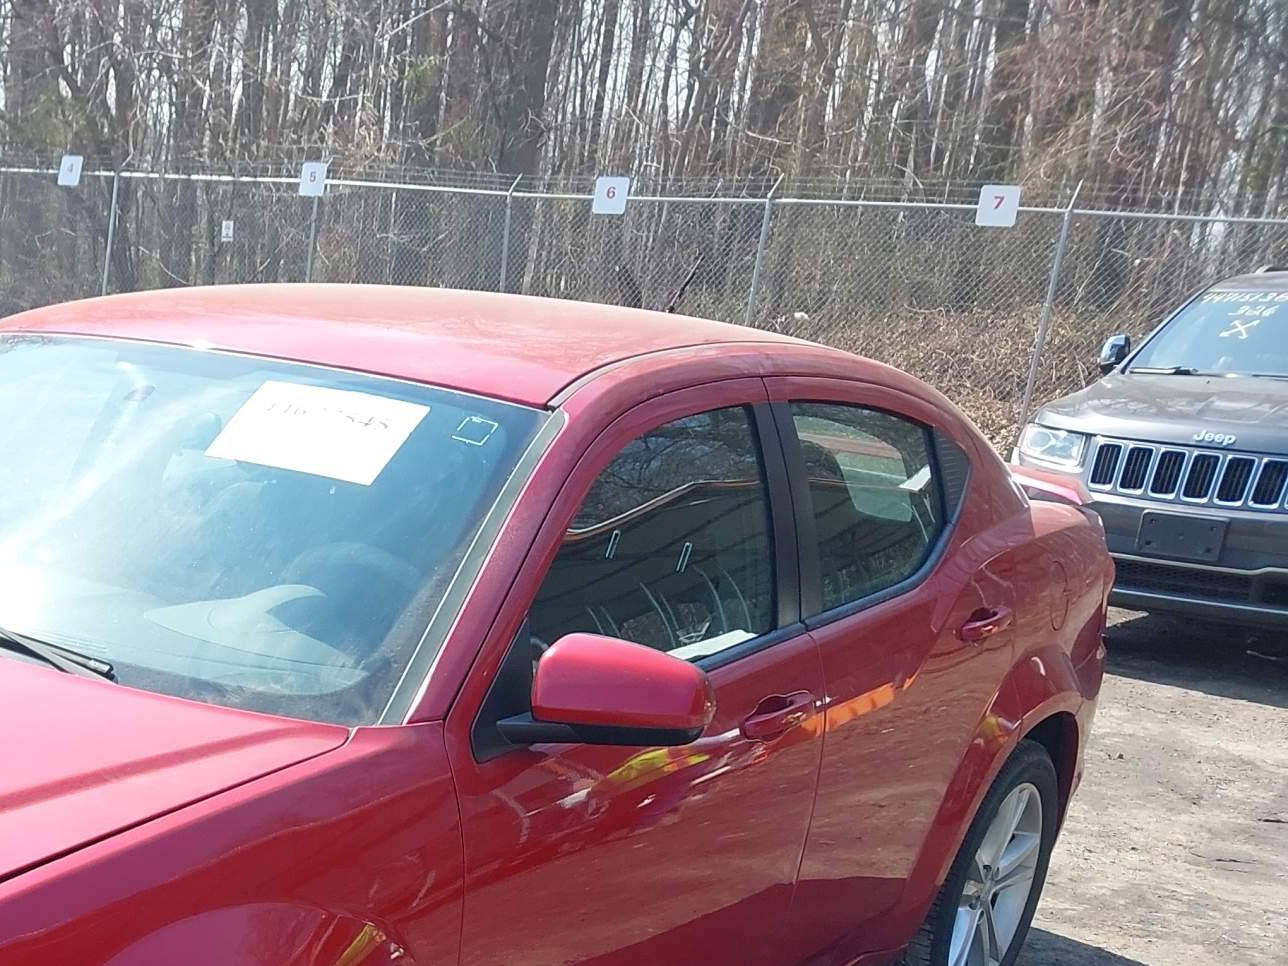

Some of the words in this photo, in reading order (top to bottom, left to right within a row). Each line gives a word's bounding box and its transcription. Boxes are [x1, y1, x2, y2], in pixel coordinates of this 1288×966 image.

[309, 171, 316, 182] 5
[606, 186, 616, 199] 6
[994, 196, 1005, 209] 7
[1193, 430, 1236, 446] Jeep
